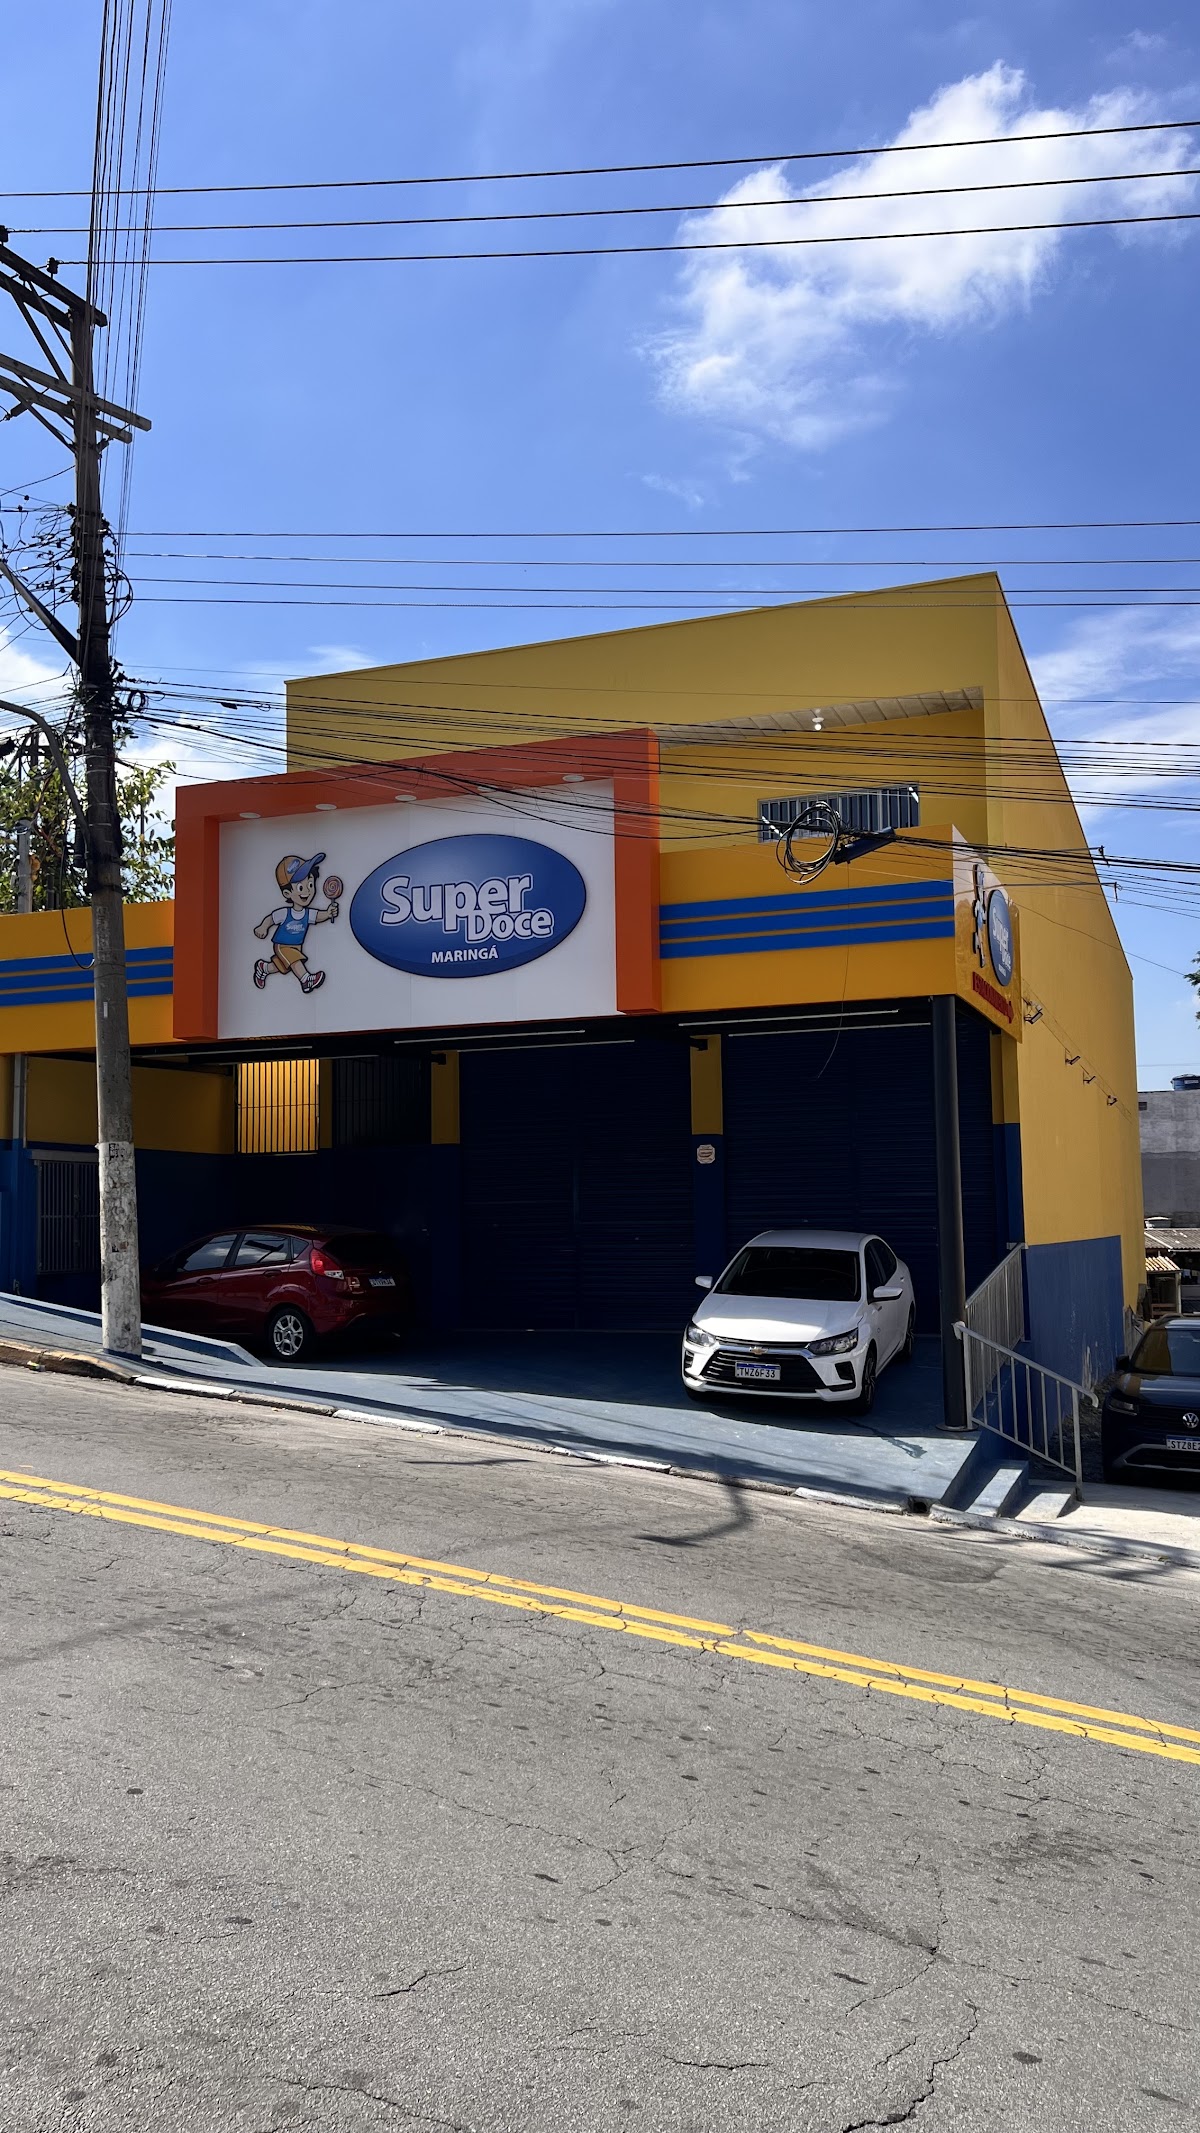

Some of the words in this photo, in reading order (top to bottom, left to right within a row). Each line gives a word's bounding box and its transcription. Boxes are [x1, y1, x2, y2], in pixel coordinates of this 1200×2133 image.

[381, 874, 533, 932] Super
[466, 910, 554, 943] Doce
[431, 945, 499, 963] MARINGÁ
